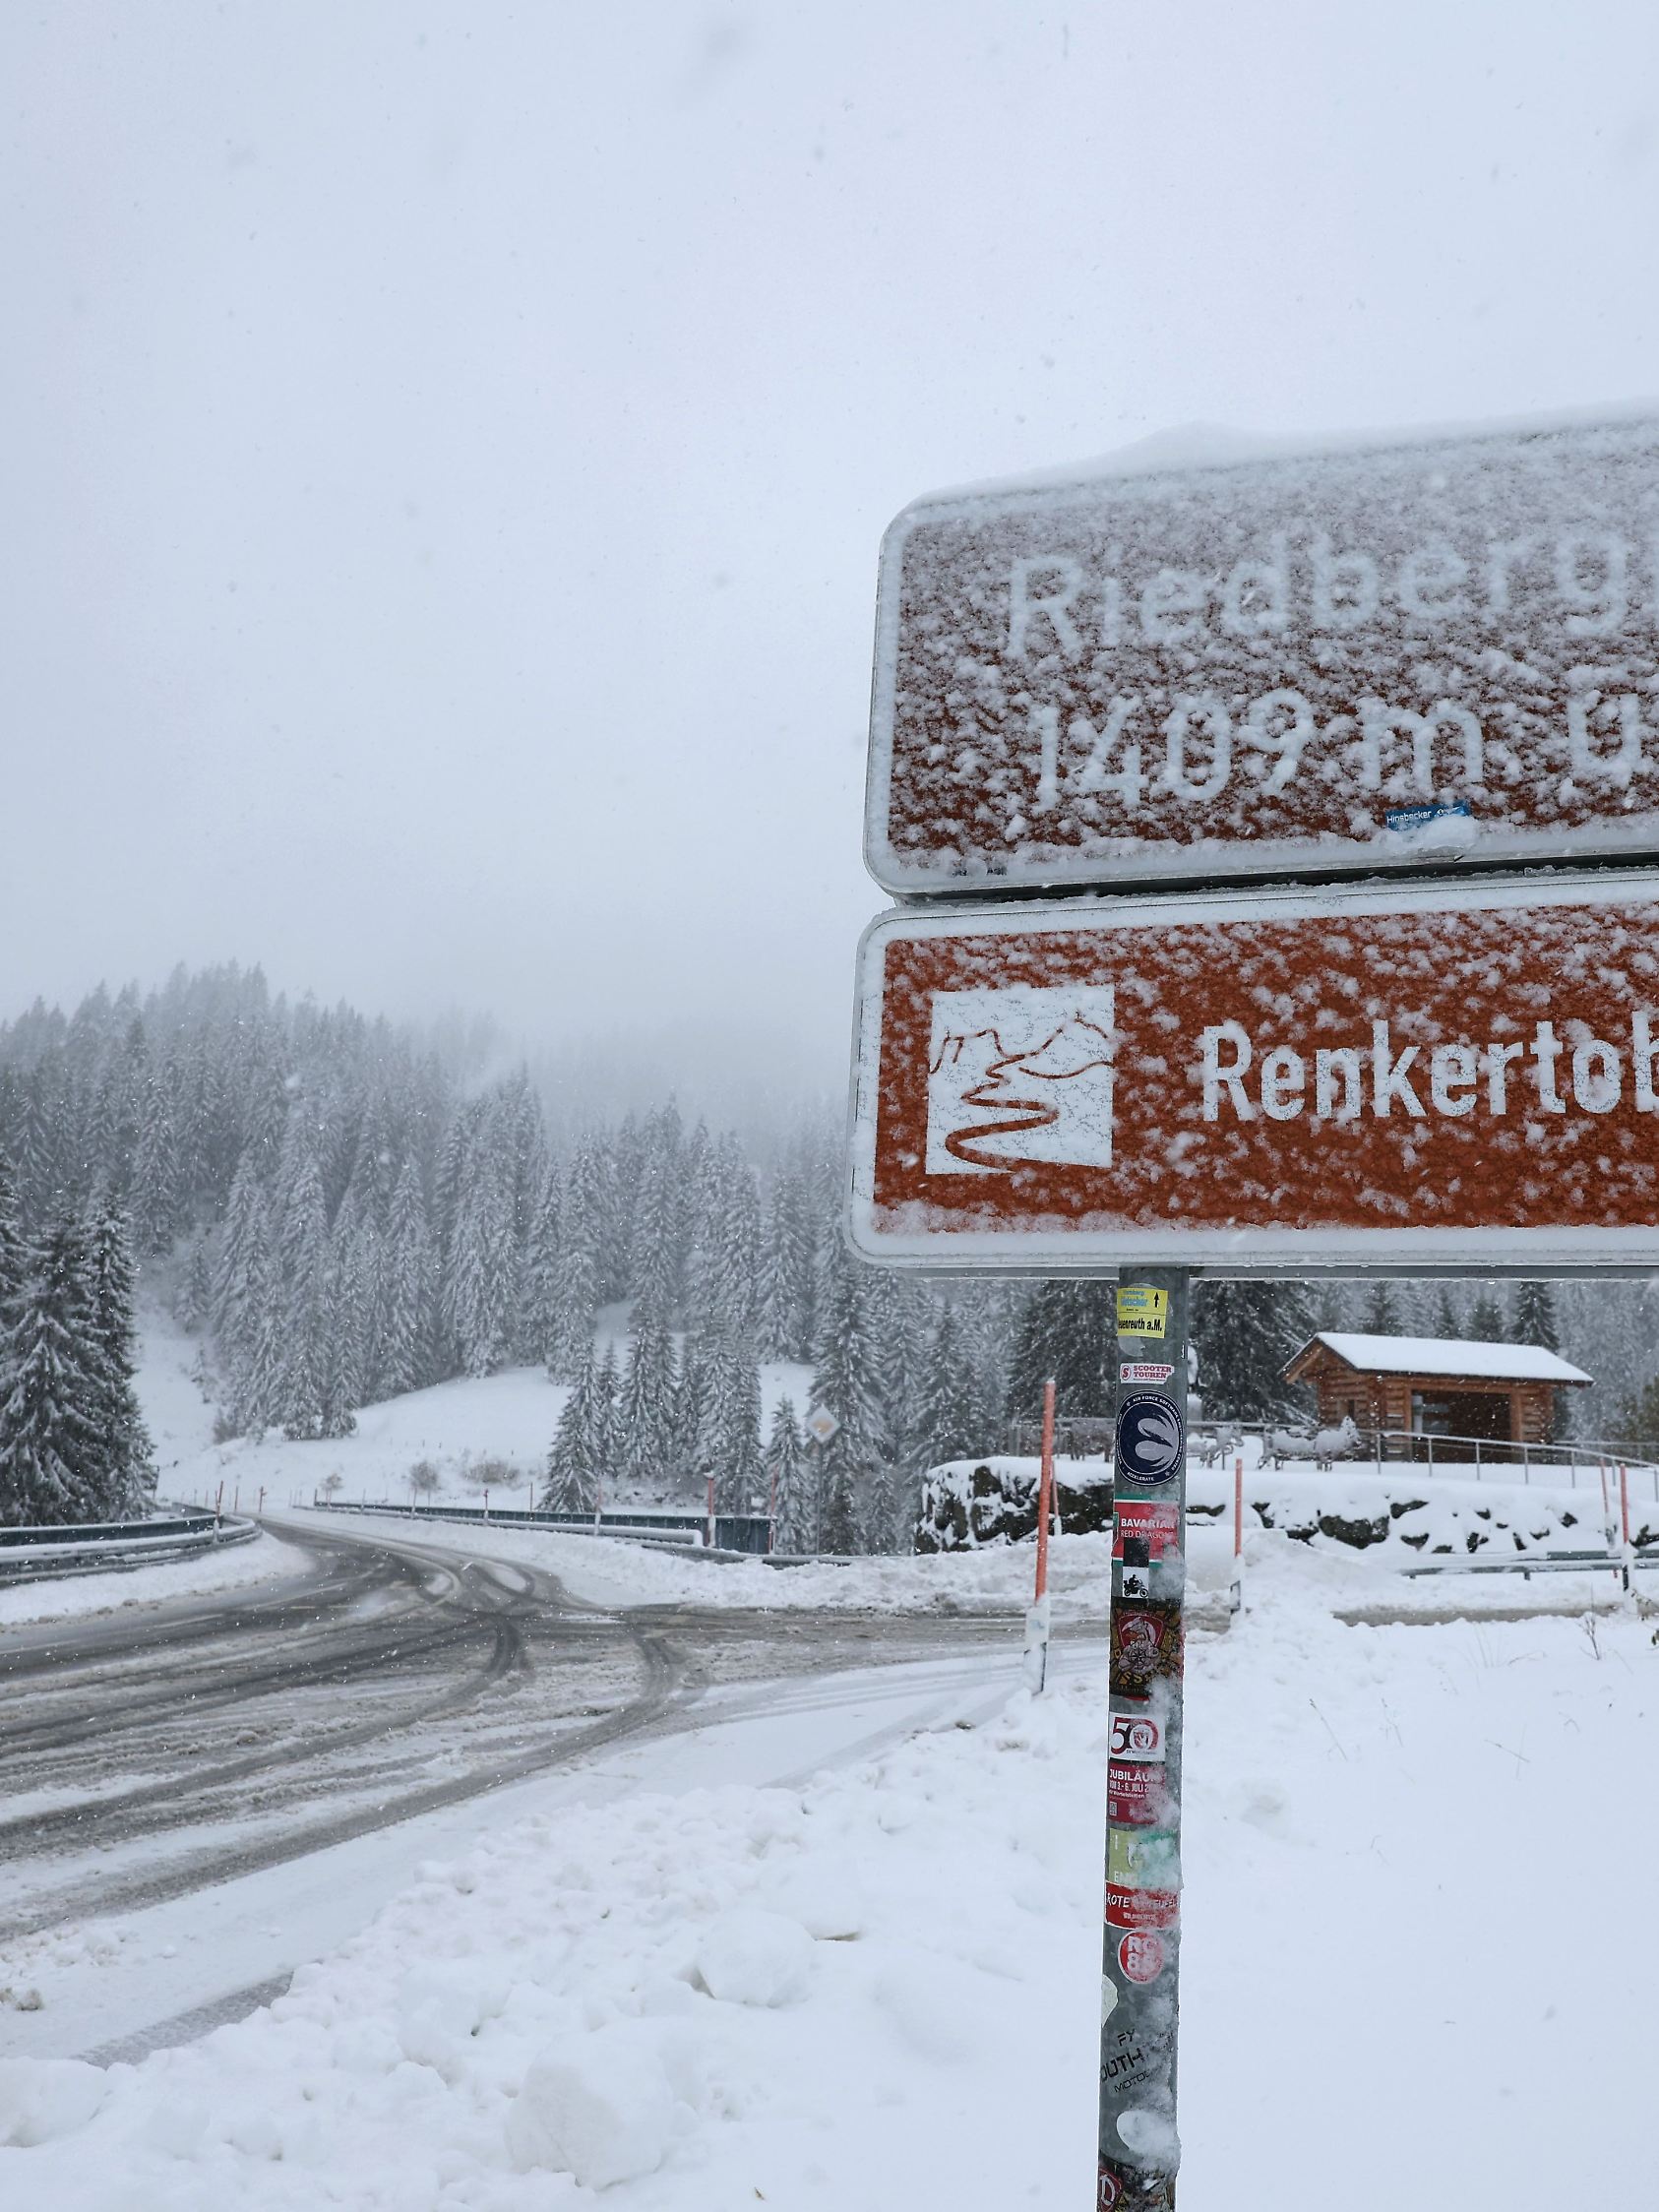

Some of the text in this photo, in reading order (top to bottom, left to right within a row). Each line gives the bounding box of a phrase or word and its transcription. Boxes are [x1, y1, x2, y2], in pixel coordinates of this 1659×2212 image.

[1030, 689, 1313, 810] 1409
[1361, 699, 1483, 788] m
[1202, 1011, 1659, 1122] Renkertob
[1110, 1769, 1161, 1782] JUBILÄU
